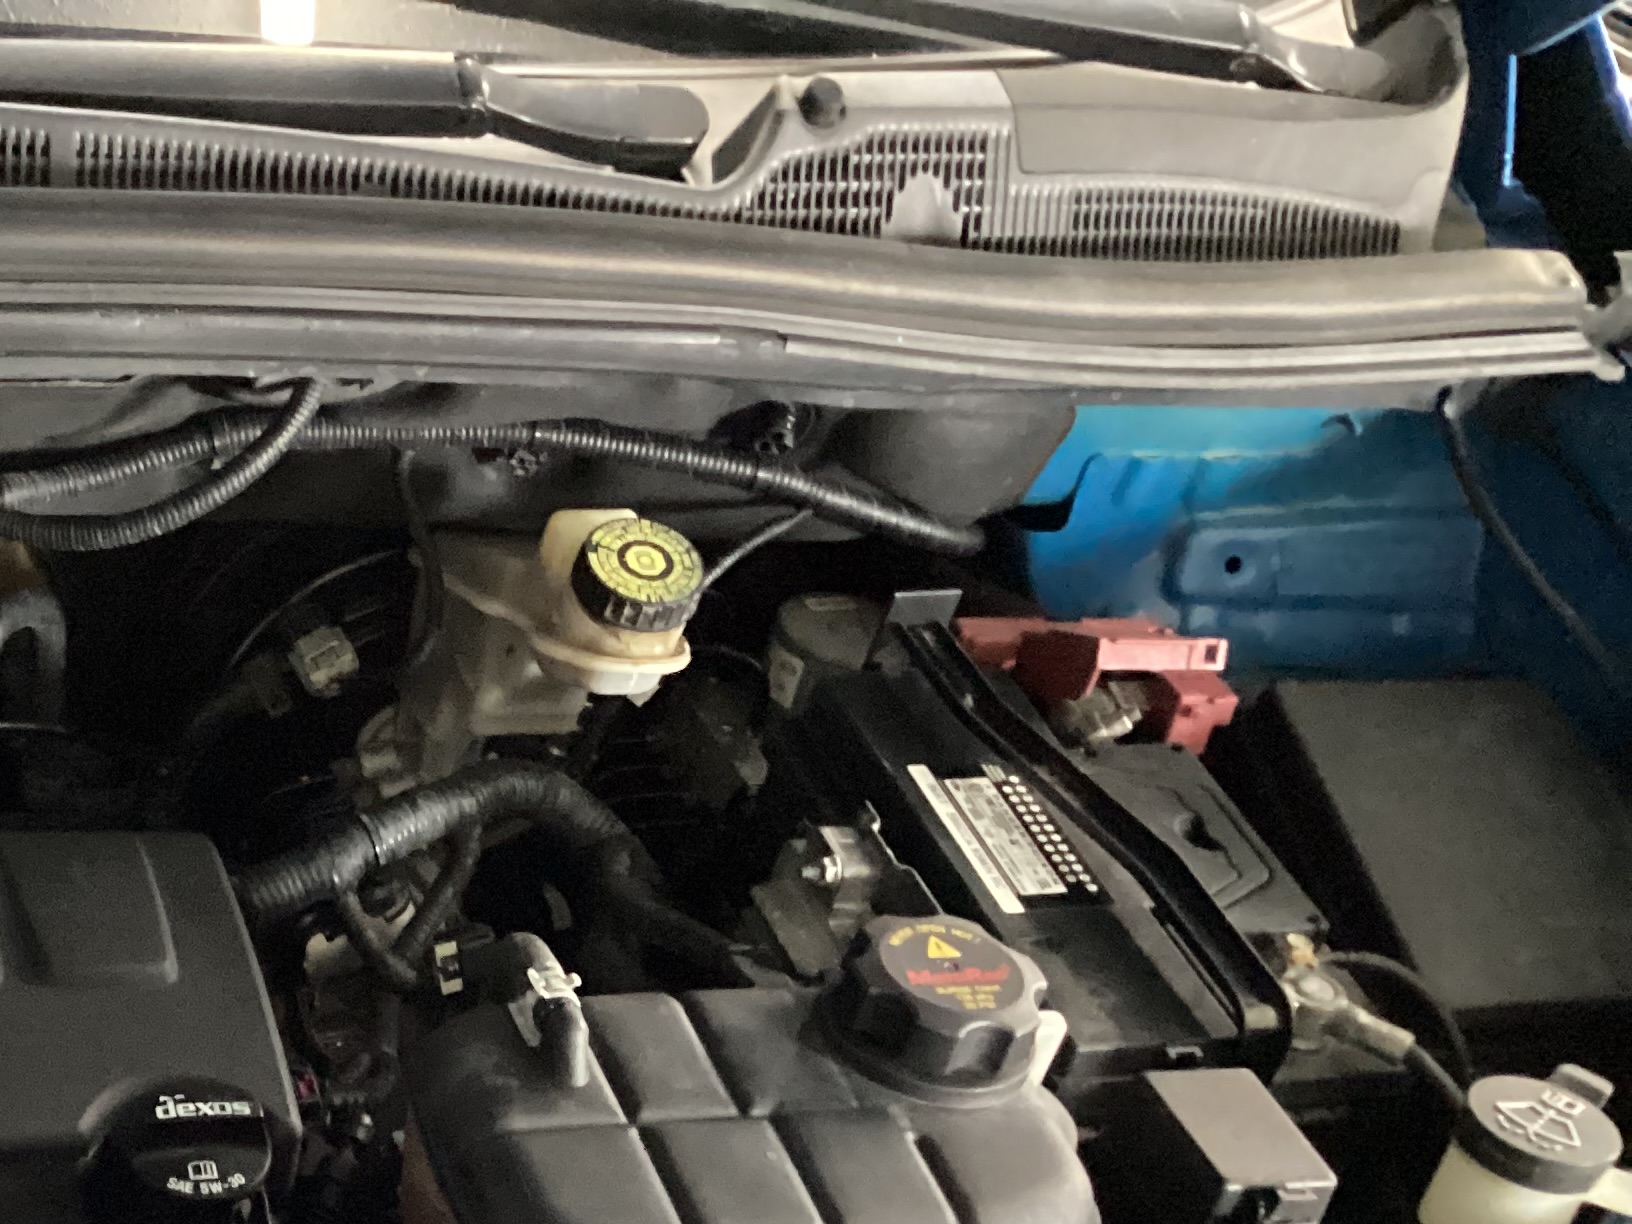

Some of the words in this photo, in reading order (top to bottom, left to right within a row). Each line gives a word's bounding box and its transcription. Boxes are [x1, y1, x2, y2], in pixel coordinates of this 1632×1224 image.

[155, 1094, 251, 1119] dexos
[167, 1177, 194, 1194] SAE
[199, 1173, 245, 1195] 5W-30
